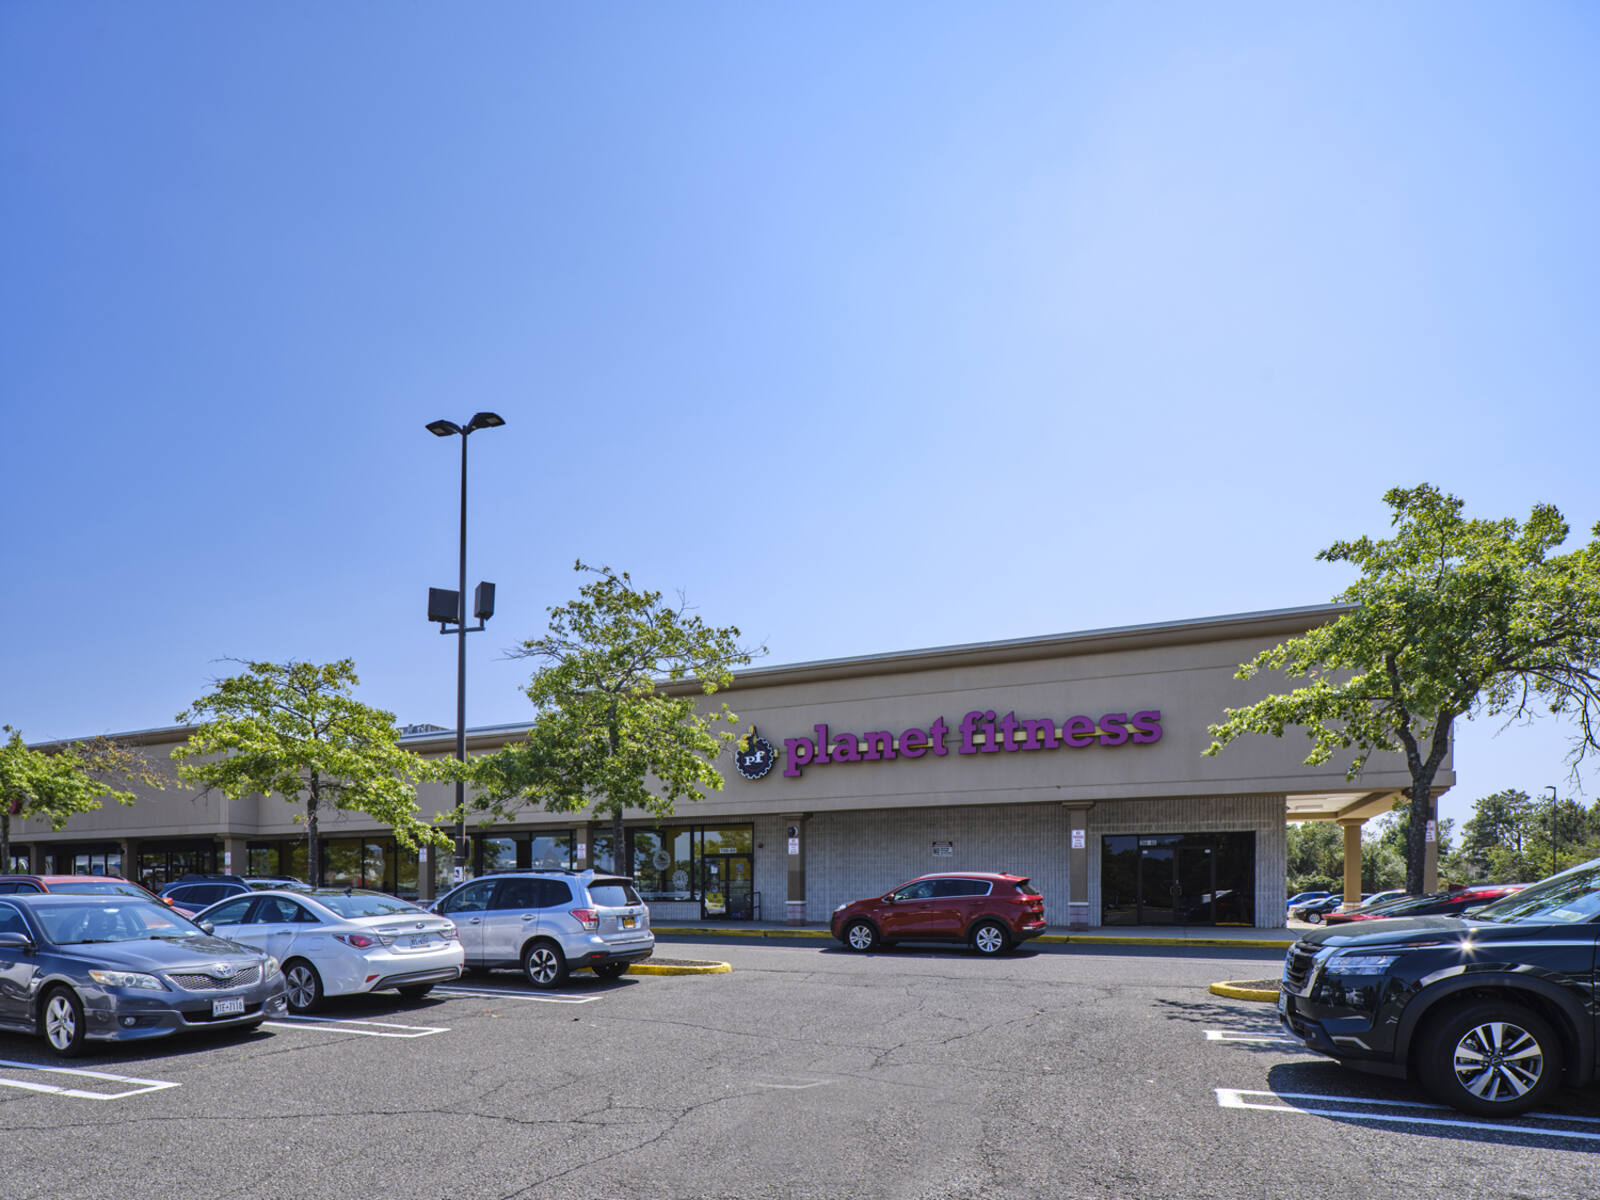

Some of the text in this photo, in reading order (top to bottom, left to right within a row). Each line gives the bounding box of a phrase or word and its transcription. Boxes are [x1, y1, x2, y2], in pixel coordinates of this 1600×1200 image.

[744, 751, 766, 766] pf
[783, 709, 1163, 777] planet fitness
